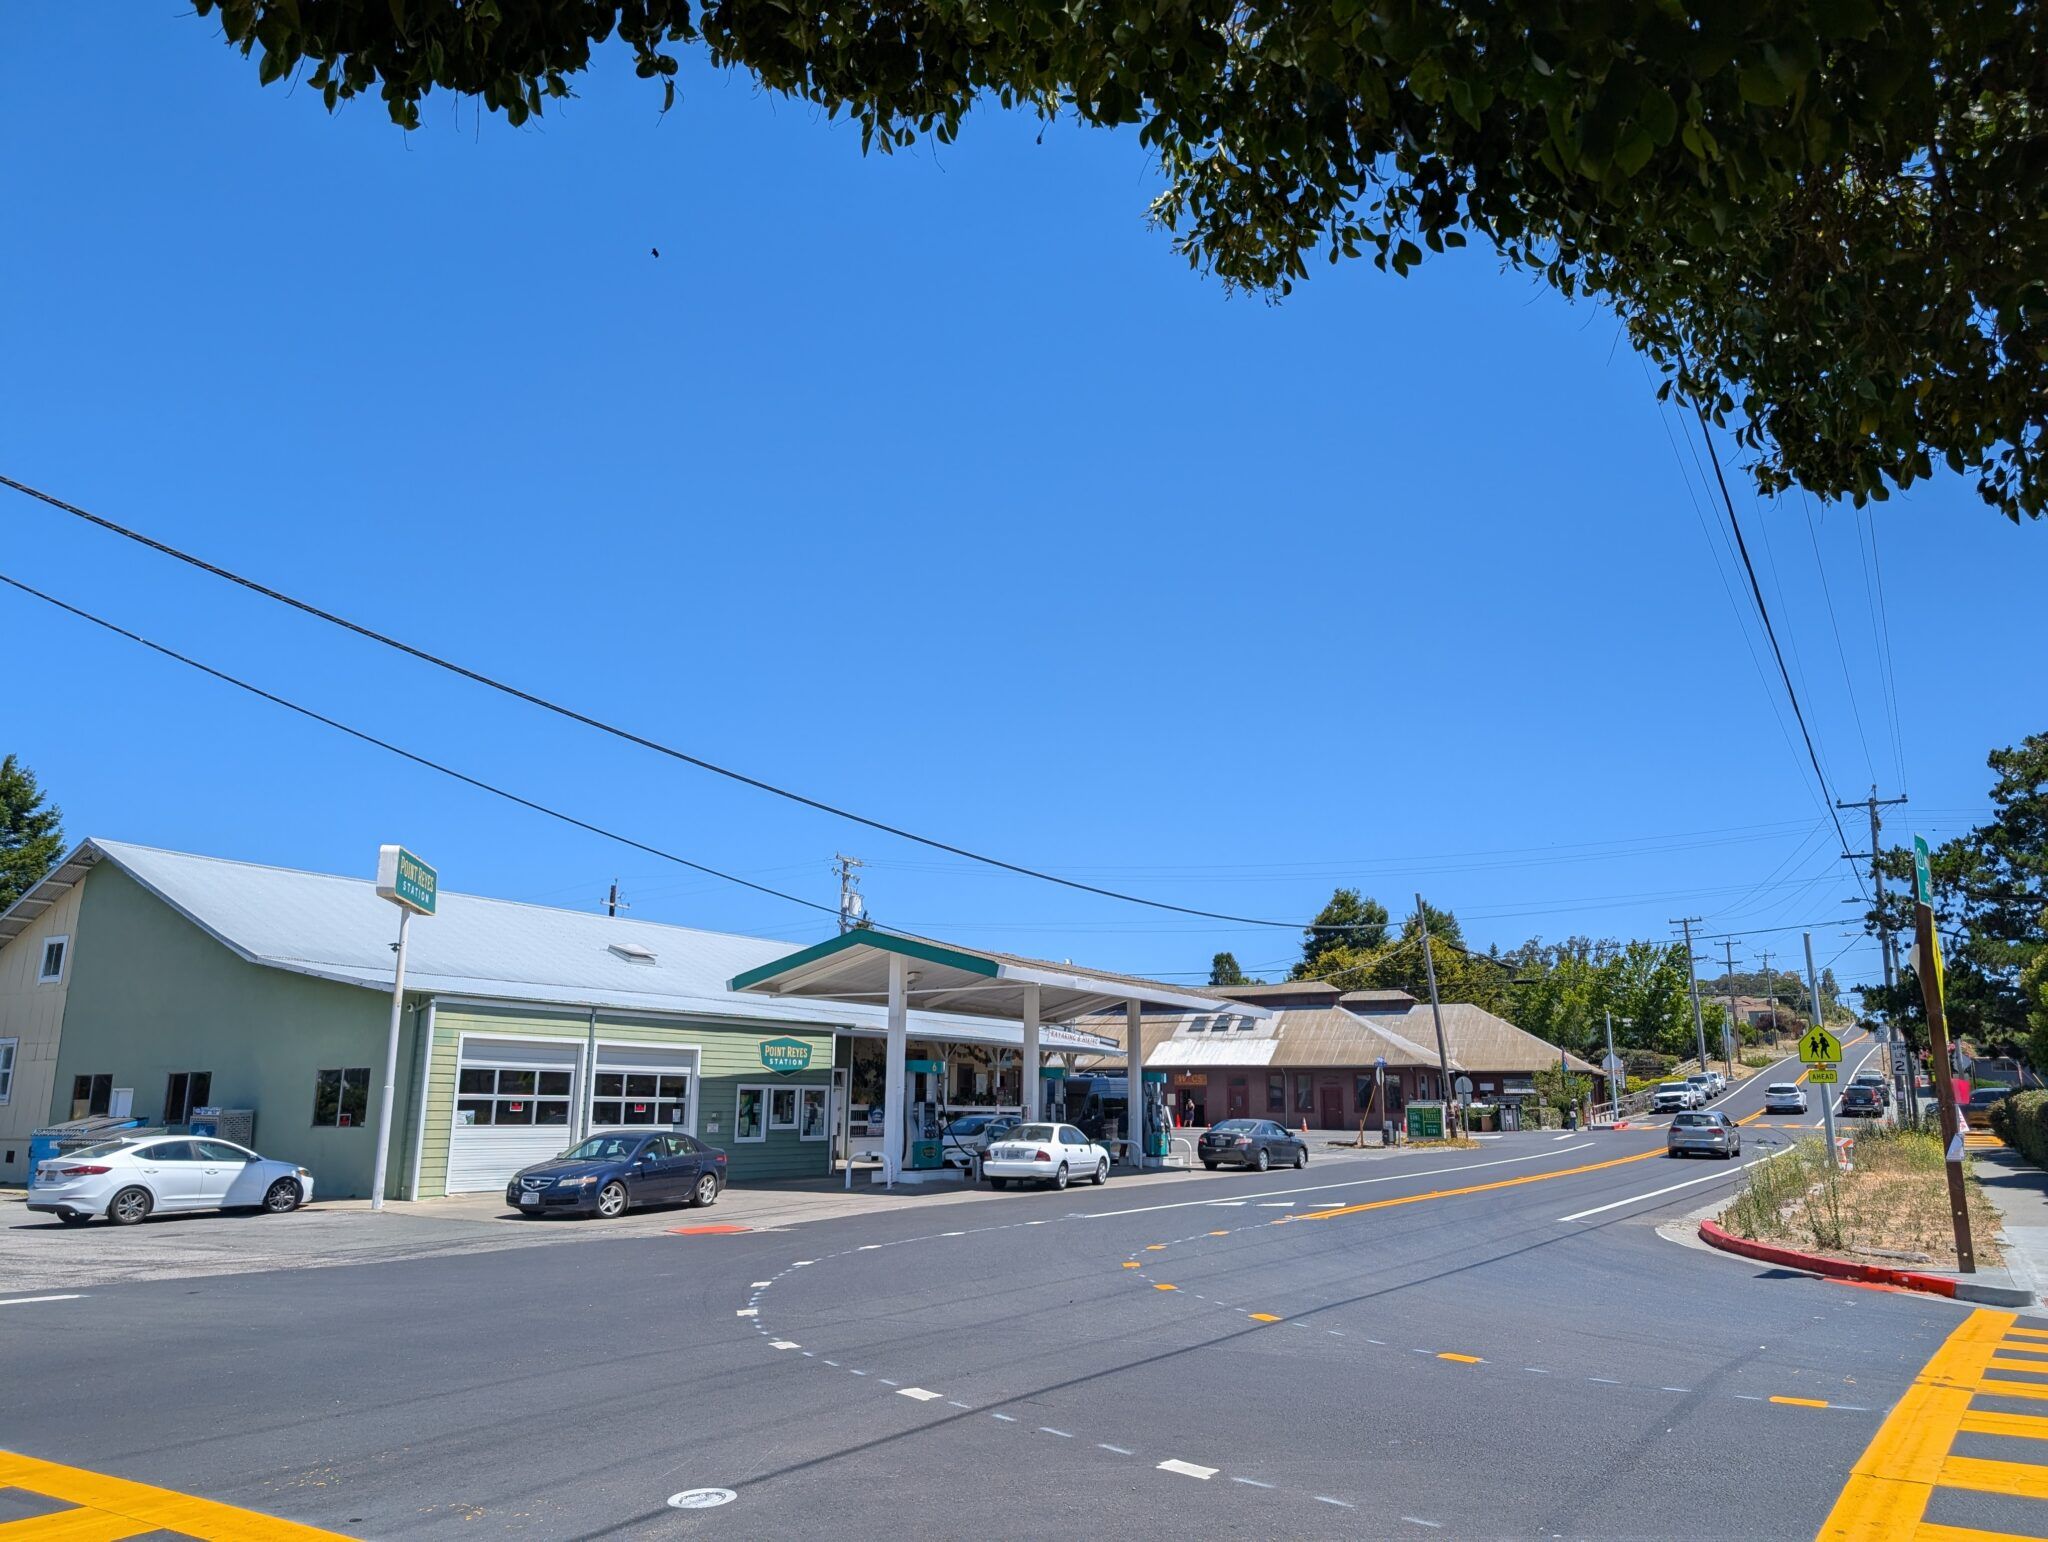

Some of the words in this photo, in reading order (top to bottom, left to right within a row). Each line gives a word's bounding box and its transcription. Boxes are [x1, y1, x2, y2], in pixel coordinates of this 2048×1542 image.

[400, 856, 418, 882] POINT
[418, 867, 433, 892] REYES
[403, 880, 430, 903] STATION
[765, 1045, 785, 1057] POINT
[787, 1046, 808, 1058] REYES
[932, 1062, 937, 1072] 6
